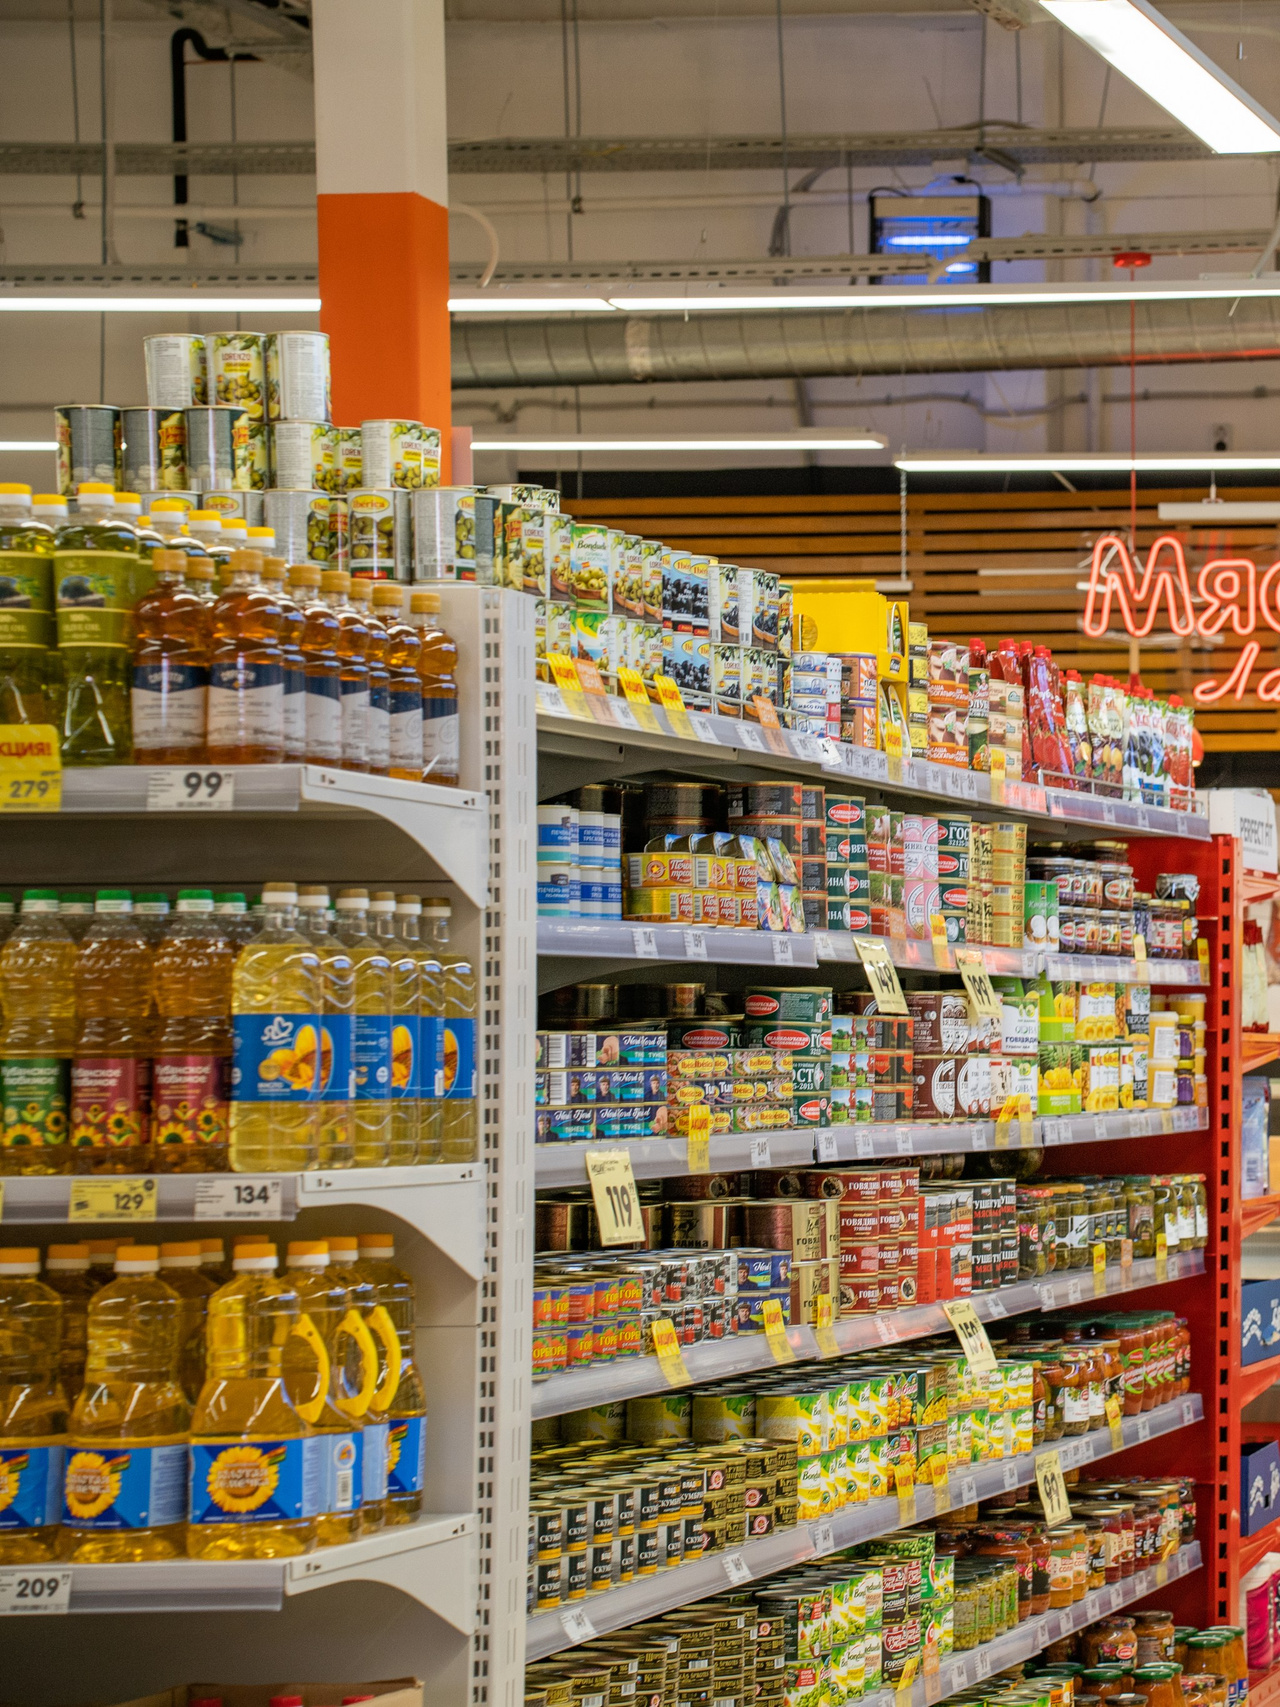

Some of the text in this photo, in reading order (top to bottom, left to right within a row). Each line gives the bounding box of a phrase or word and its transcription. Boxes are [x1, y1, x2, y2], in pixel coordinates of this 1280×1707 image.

[10, 780, 50, 799] 279
[183, 772, 223, 798] 99
[967, 975, 991, 1006] 199
[114, 1193, 143, 1211] 129
[234, 1186, 269, 1204] 134
[605, 1185, 632, 1228] 119
[16, 1578, 60, 1598] 209
